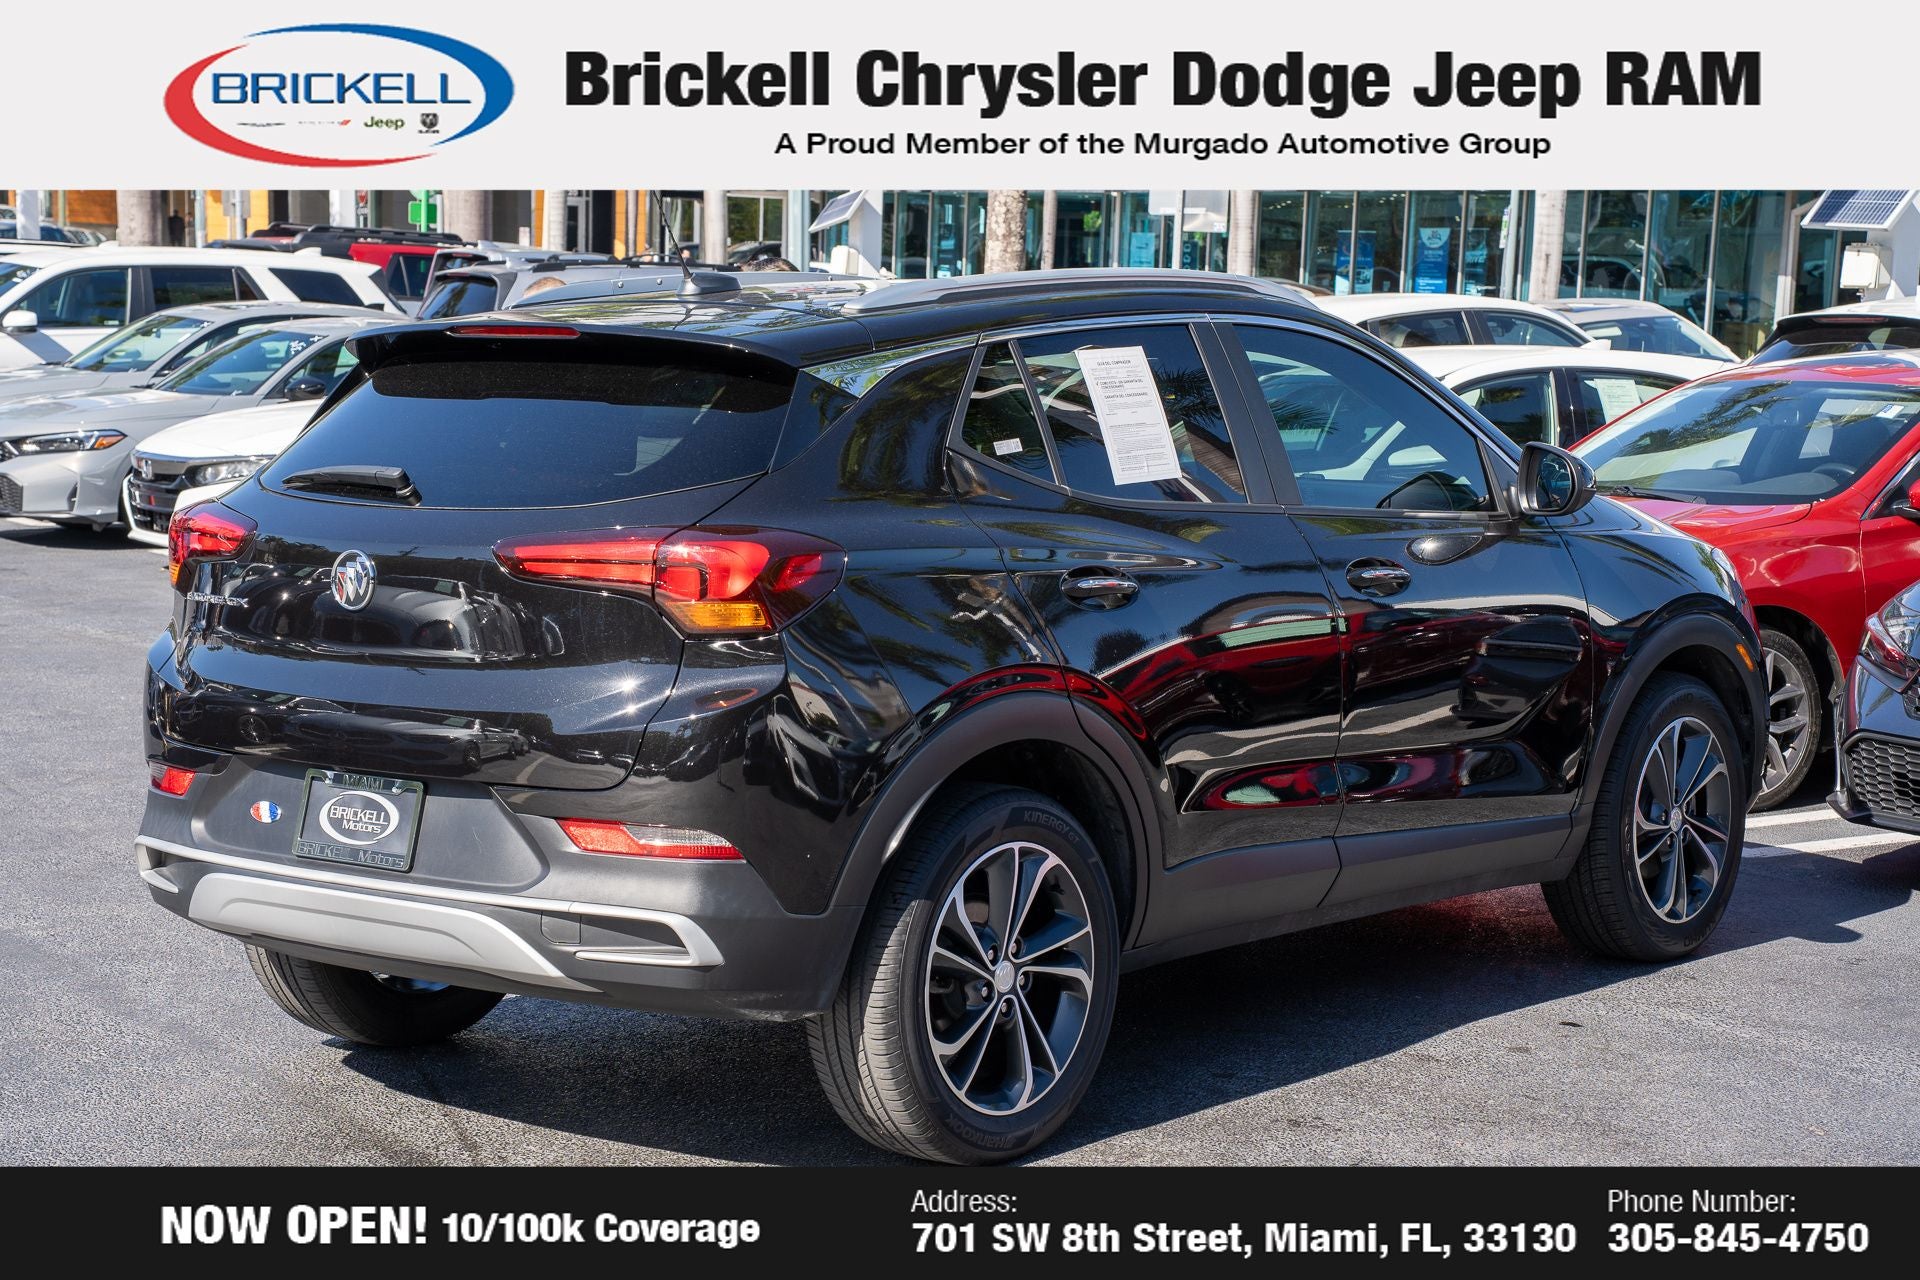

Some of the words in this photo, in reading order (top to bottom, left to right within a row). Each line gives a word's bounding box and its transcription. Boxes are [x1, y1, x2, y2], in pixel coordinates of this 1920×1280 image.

[330, 805, 388, 825] BRICKELL
[342, 820, 381, 834] Motors
[298, 841, 354, 861] BRICKELL
[357, 850, 404, 869] Motors
